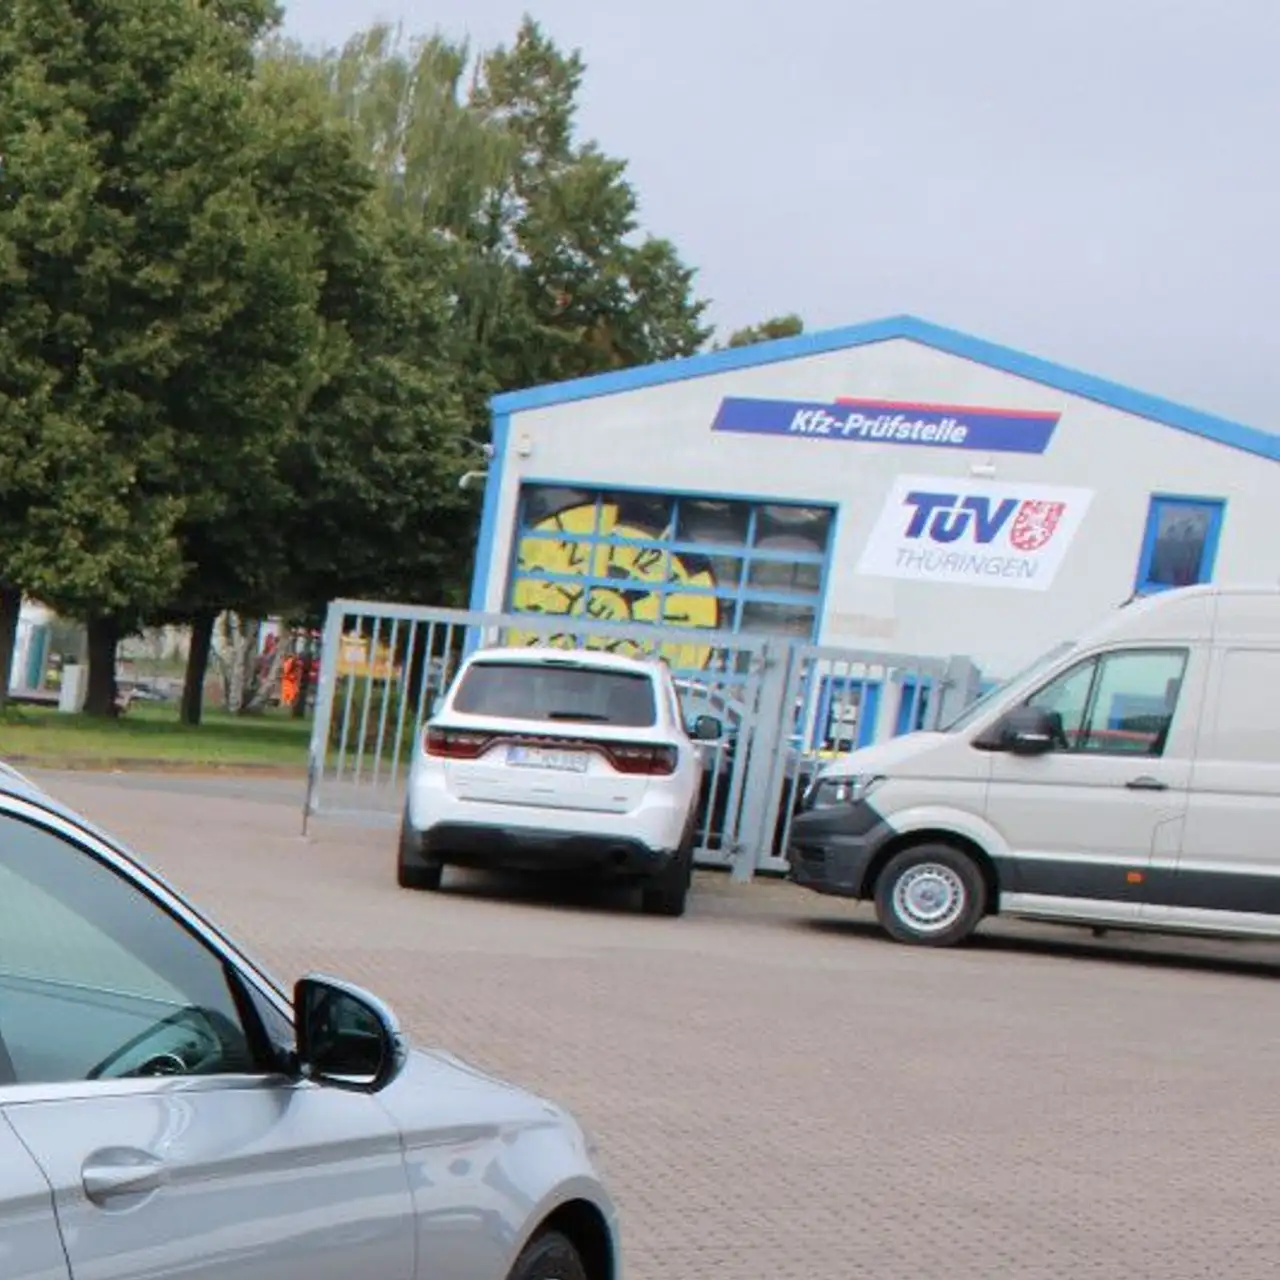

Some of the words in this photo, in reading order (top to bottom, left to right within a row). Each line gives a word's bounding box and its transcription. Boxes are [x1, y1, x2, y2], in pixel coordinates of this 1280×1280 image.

[790, 409, 968, 443] Kfz-Prüfstelle
[903, 491, 1022, 543] TÜV
[895, 545, 1039, 578] THÜRINGEN
